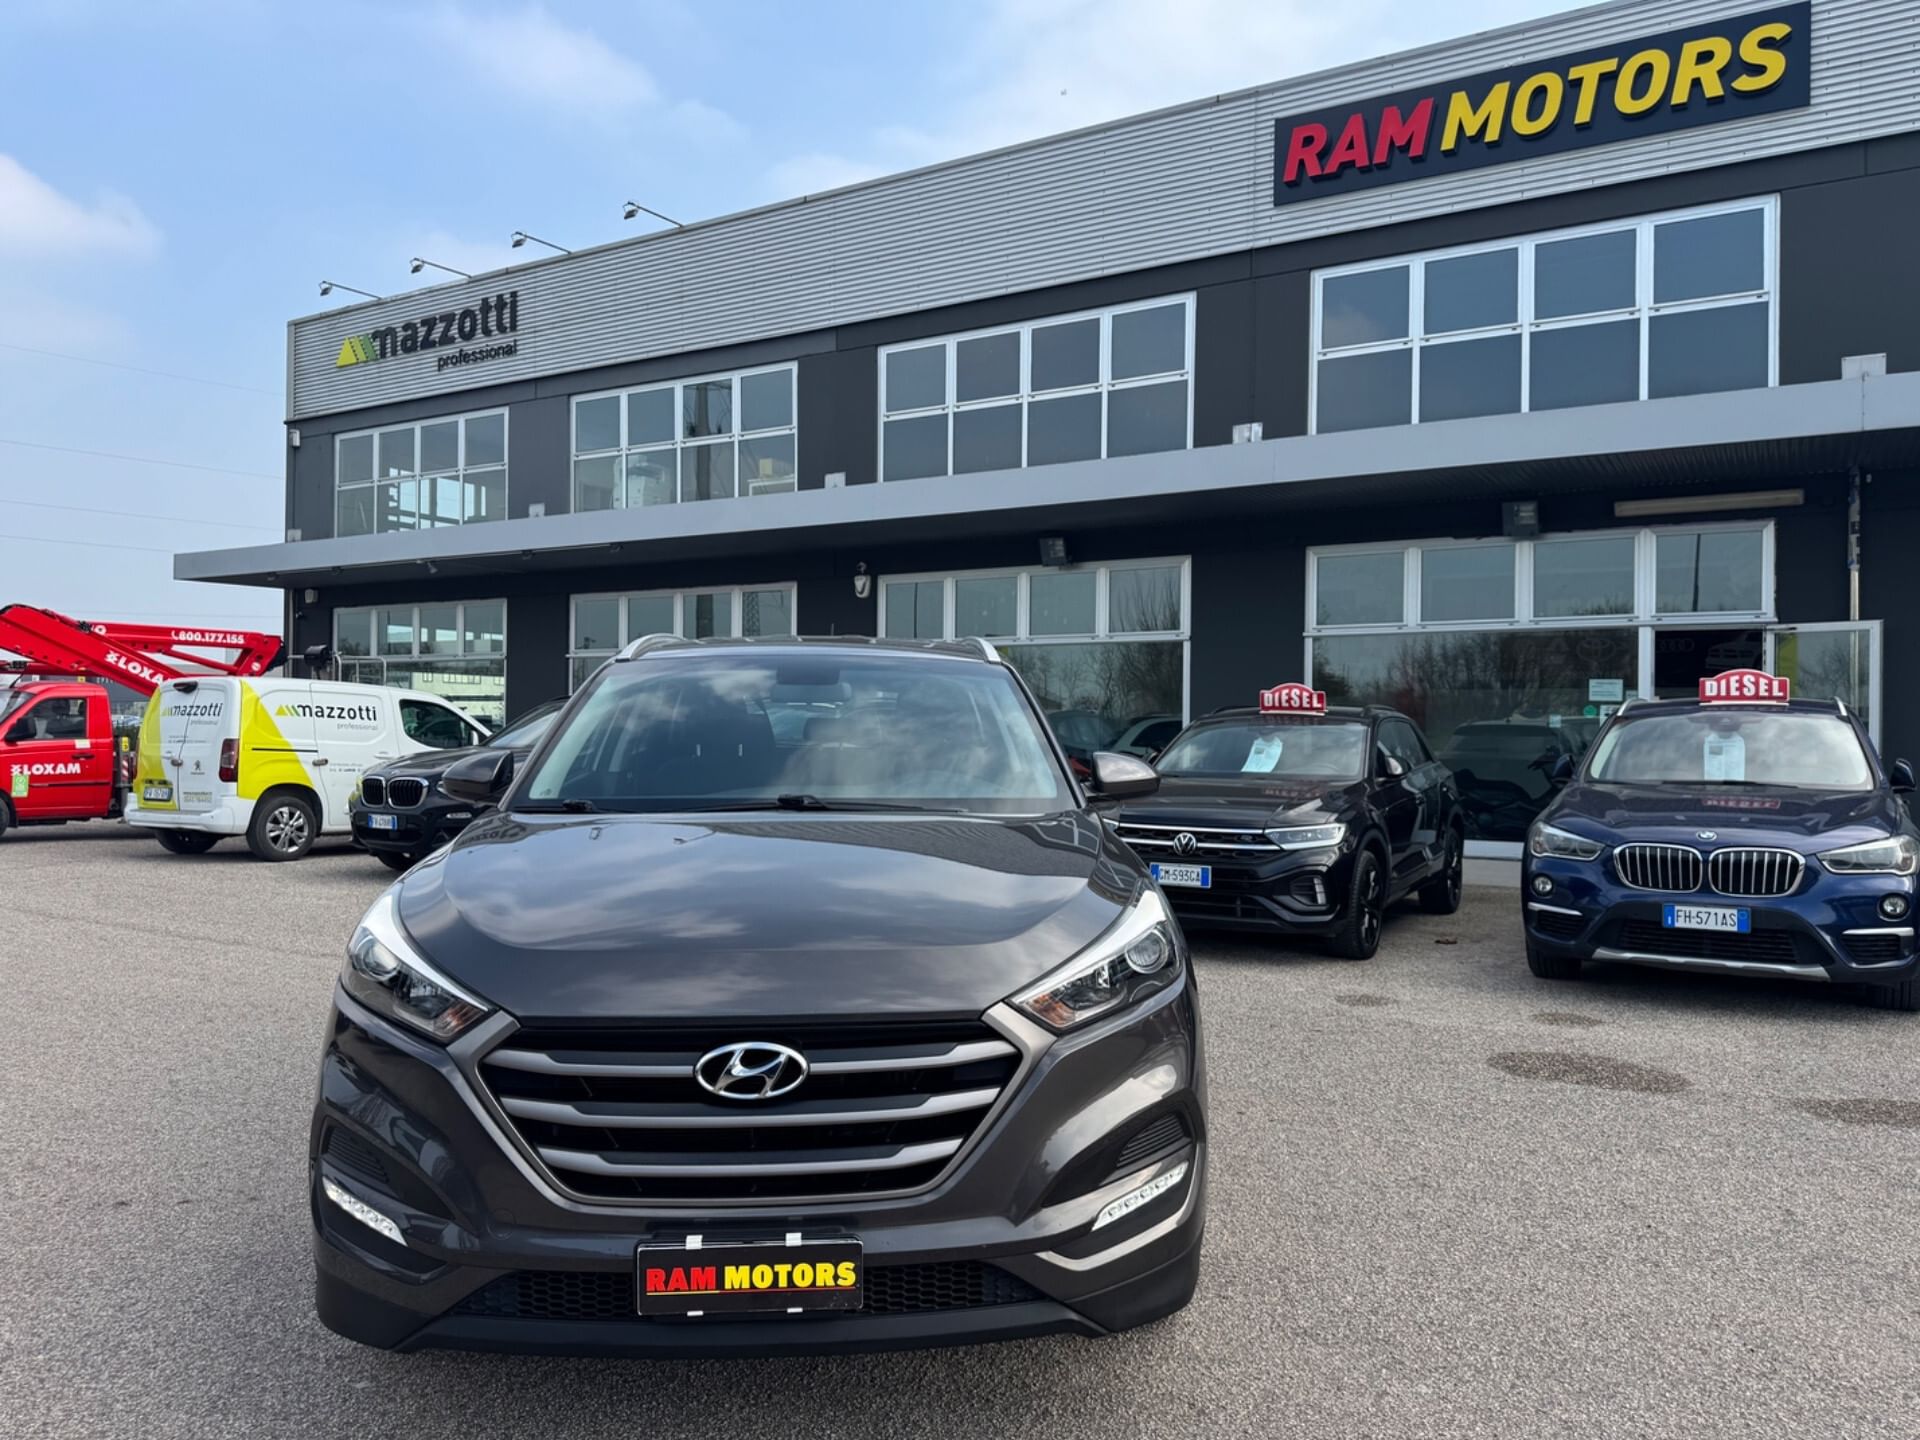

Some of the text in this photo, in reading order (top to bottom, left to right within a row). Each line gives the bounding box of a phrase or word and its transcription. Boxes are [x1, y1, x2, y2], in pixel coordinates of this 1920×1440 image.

[1282, 22, 1793, 183] RAM MOTORS
[369, 290, 518, 360] mazzotti
[437, 338, 518, 372] professional
[117, 655, 173, 685] LOXA
[1263, 687, 1322, 709] DIESEL
[1705, 674, 1784, 697] DIESEL
[171, 702, 224, 718] mazzotti
[296, 704, 378, 721] mazzotti
[22, 762, 82, 776] LOXAM
[645, 1261, 857, 1292] RAM MOTORS
